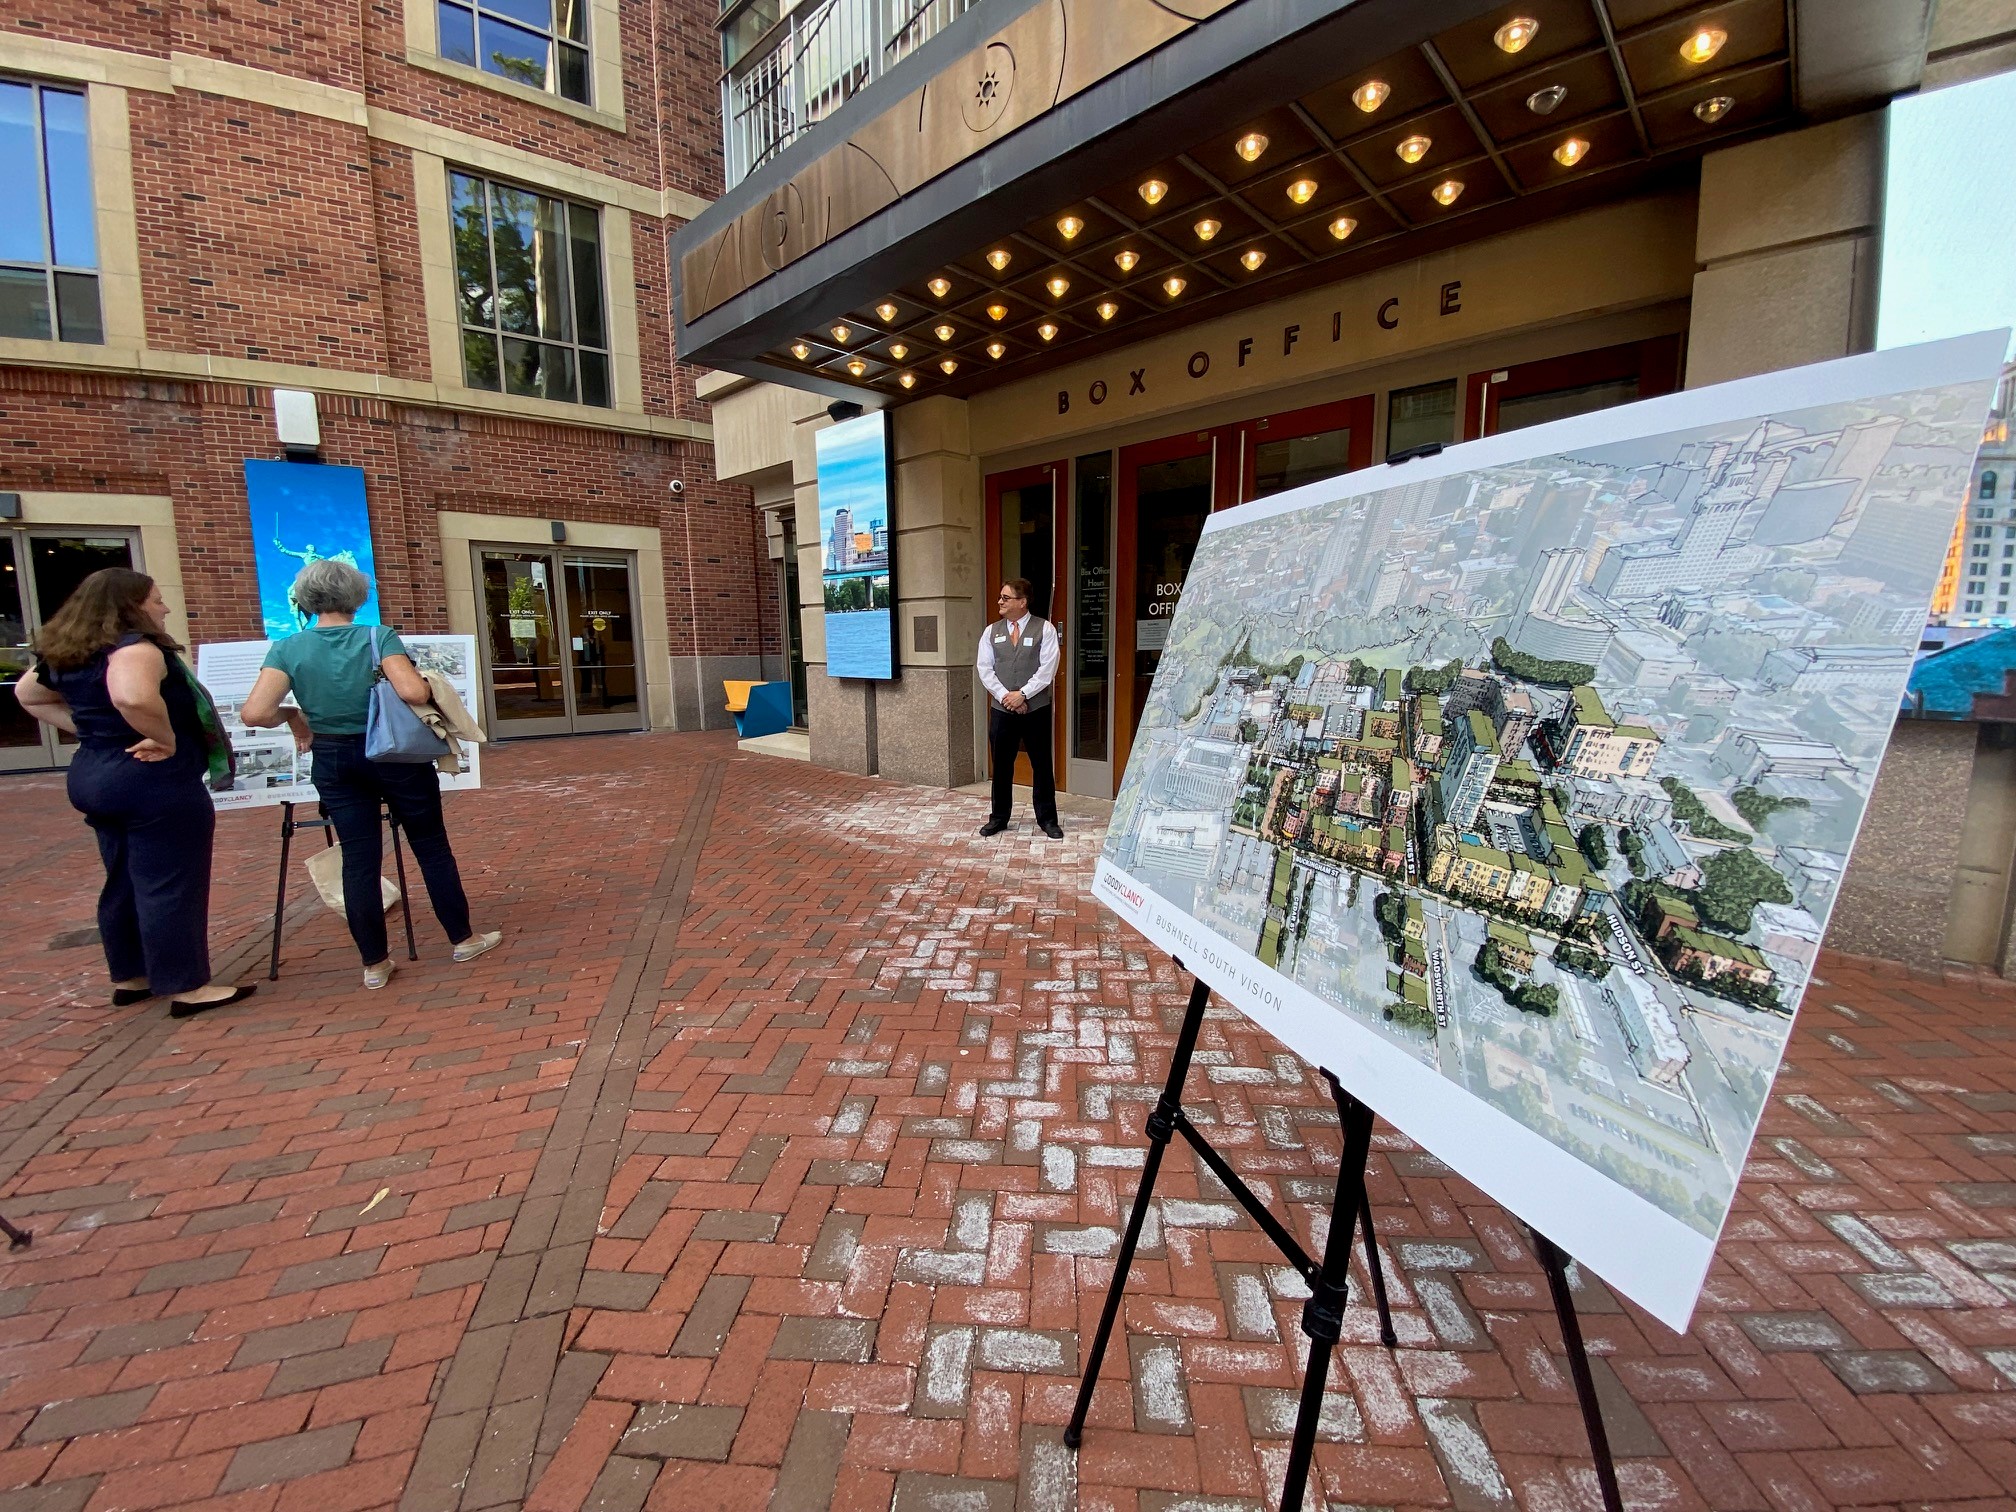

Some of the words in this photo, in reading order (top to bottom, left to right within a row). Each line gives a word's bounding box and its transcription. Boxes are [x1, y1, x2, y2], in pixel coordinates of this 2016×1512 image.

[1058, 368, 1146, 415] BOX
[1187, 280, 1462, 379] OFFICE
[1080, 567, 1091, 576] Box
[1156, 582, 1182, 596] BOX
[1148, 601, 1175, 615] OFFI
[1272, 756, 1290, 767] CAPITOL
[213, 794, 253, 804] ODYCLANCY
[1406, 839, 1414, 863] WEST
[1295, 855, 1331, 875] BUCKINGHAM
[1330, 869, 1340, 877] ST
[1408, 863, 1415, 875] ST
[1291, 896, 1299, 922] CEDAR
[1606, 914, 1637, 960] HUDSON
[1630, 960, 1646, 975] ST
[1155, 914, 1198, 954] BUSHNELL
[1202, 947, 1236, 979] SOUTH
[1241, 973, 1282, 1012] VISION
[1432, 950, 1445, 1013] WADSWORTH
[1438, 1014, 1446, 1027] ST
